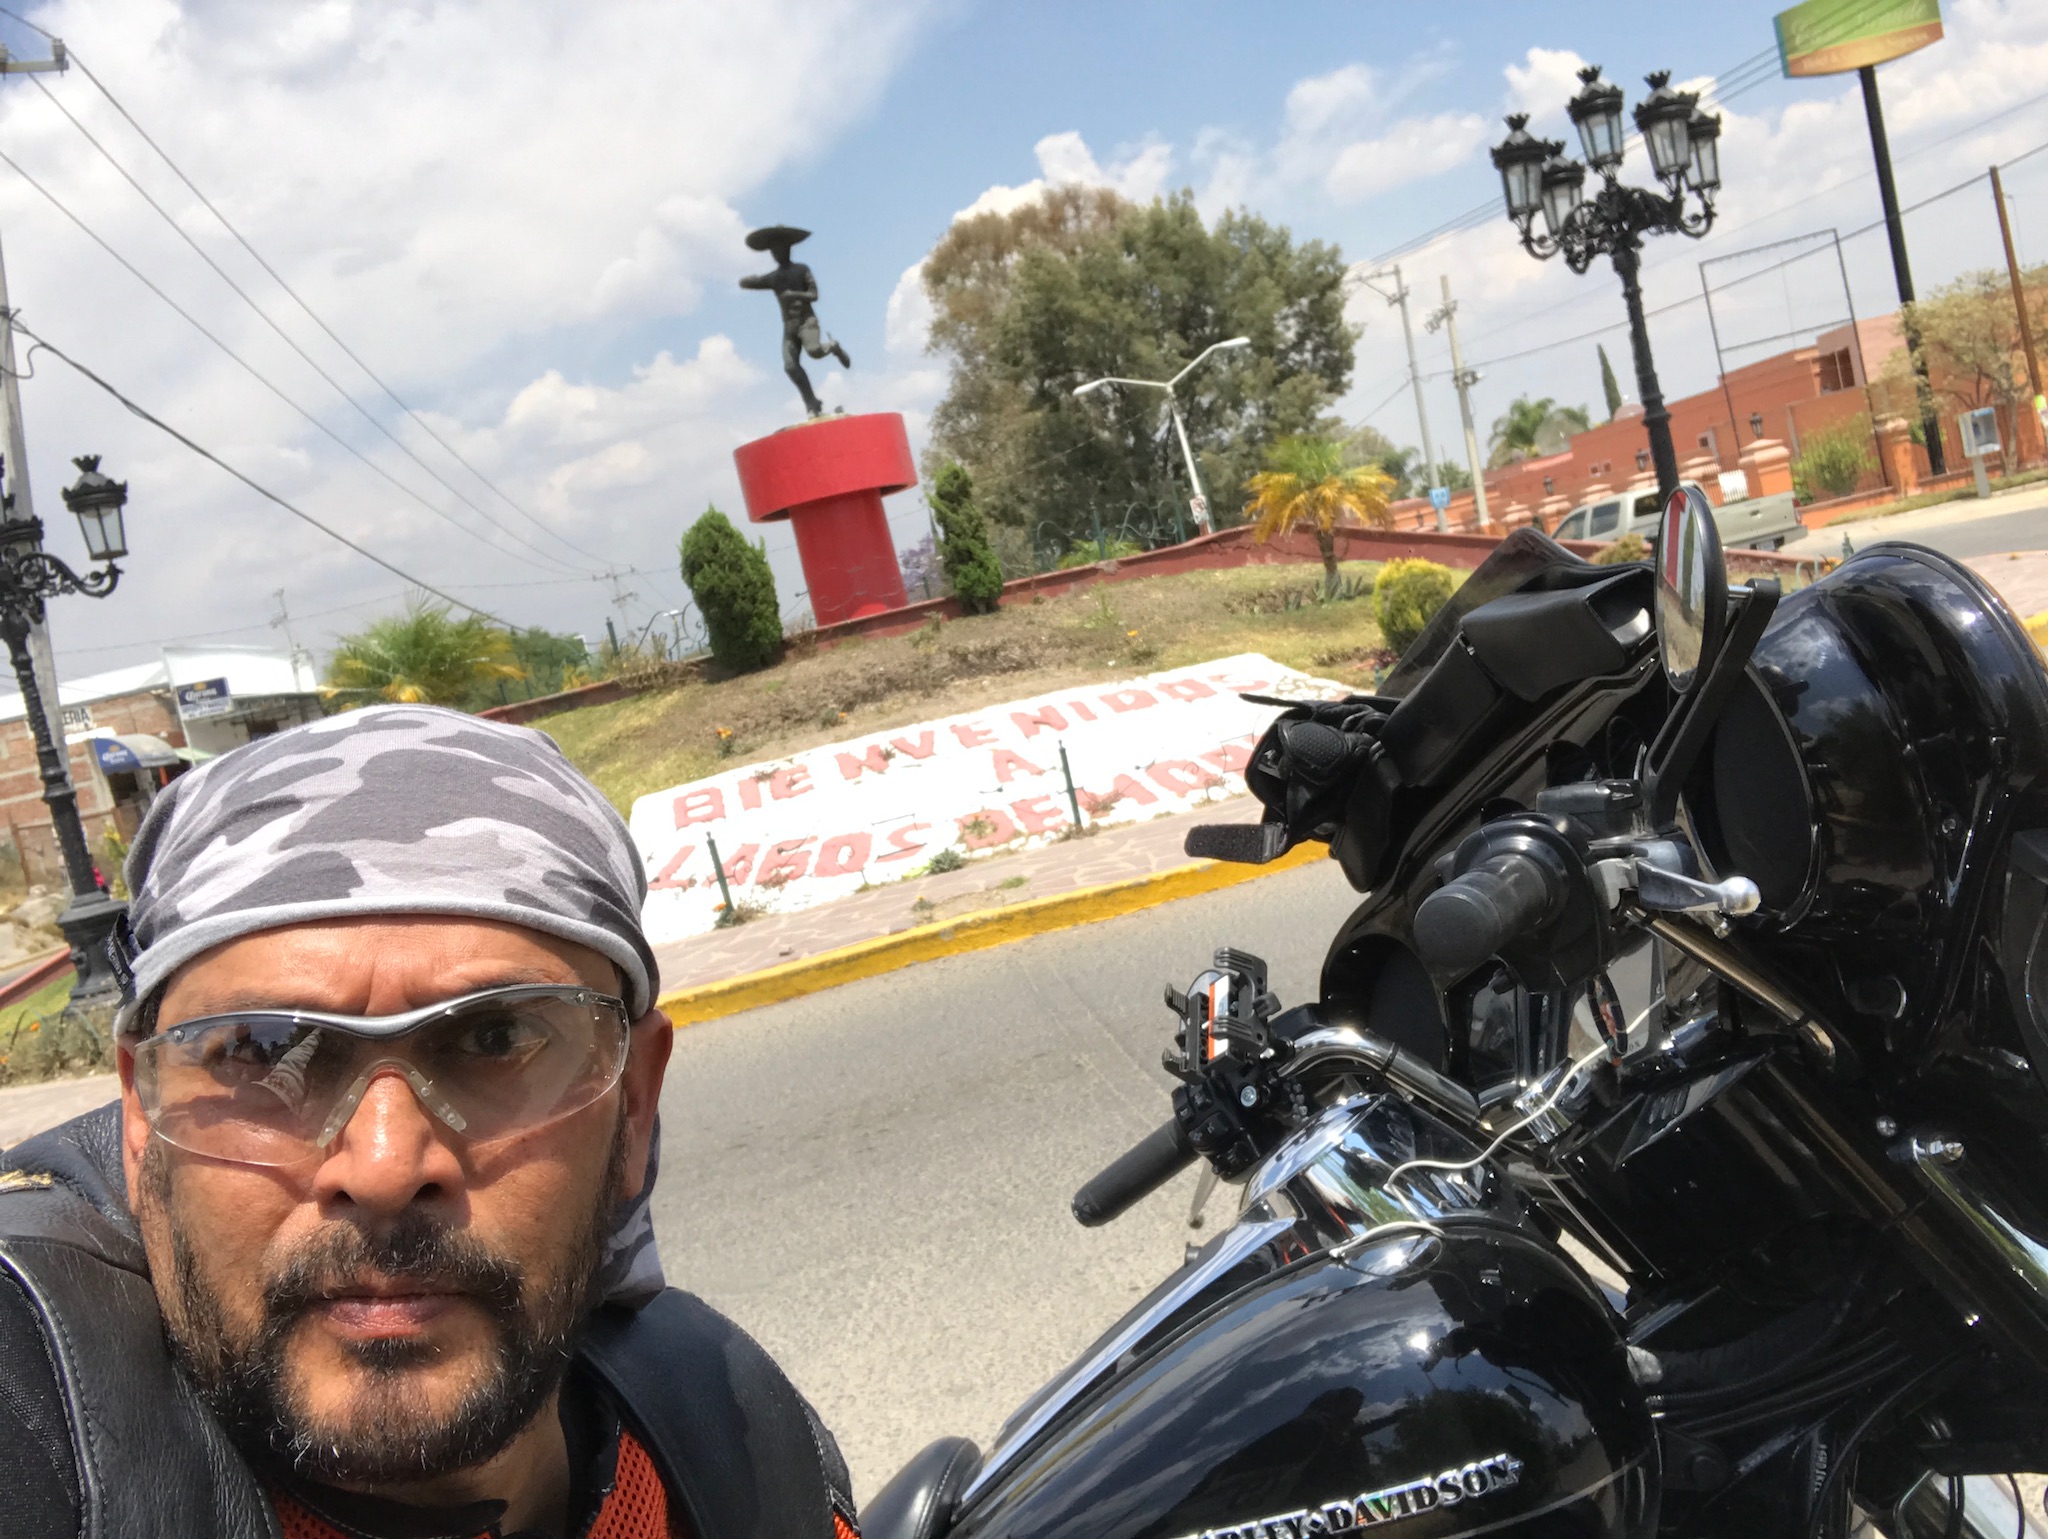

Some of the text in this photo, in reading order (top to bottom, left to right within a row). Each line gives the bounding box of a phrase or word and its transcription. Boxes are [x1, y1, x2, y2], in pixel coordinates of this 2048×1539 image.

[61, 708, 91, 725] ERIA
[673, 673, 1269, 830] BIENVENIDOS
[991, 749, 1045, 782] A
[953, 795, 1068, 849] DE
